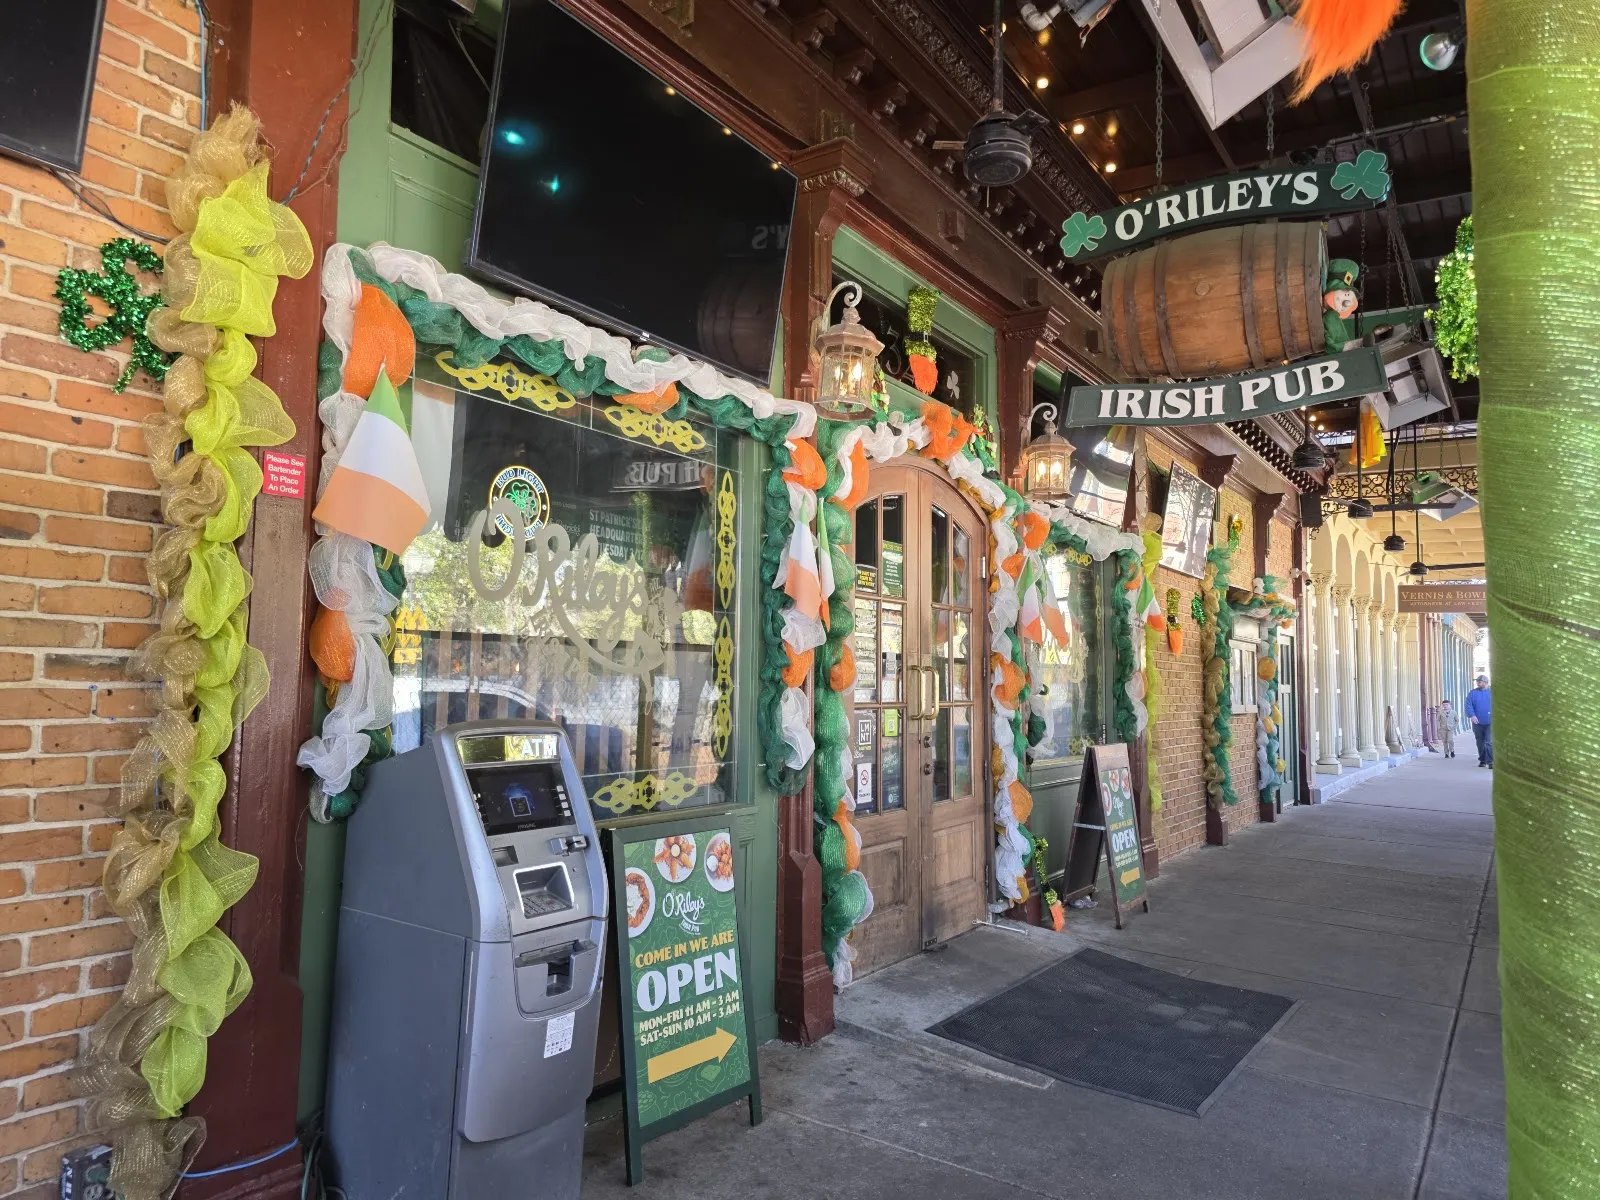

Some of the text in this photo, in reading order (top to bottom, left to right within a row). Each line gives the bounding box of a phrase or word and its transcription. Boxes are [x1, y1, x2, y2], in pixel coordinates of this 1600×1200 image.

[1114, 171, 1319, 241] O'RILEY'S
[1098, 360, 1345, 420] IRISH PUB
[266, 454, 304, 467] Please See
[268, 464, 302, 476] Bartender
[268, 483, 300, 495] An Order
[270, 474, 299, 486] To Place
[495, 468, 545, 494] BUD LIGHT
[589, 508, 600, 522] ST
[600, 511, 637, 530] PATRICK'S
[589, 523, 648, 546] HEADQUARTER
[1401, 590, 1487, 600] VERNIS & BOWL
[860, 722, 870, 733] LM
[860, 732, 870, 742] NT
[520, 737, 558, 758] ATM
[1111, 827, 1137, 853] OPEN
[635, 929, 735, 969] COME IN WE ARE
[636, 947, 738, 1012] OPEN
[639, 1008, 684, 1034] MON-FRI
[684, 1004, 694, 1017] 11
[695, 999, 711, 1014] AM
[717, 994, 724, 1006] 3
[725, 989, 740, 1004] AM
[640, 1021, 683, 1047] SAT-SUN
[683, 1017, 695, 1031] 10
[695, 1011, 712, 1027] AM
[718, 1007, 725, 1019] 3
[725, 1001, 740, 1016] AM
